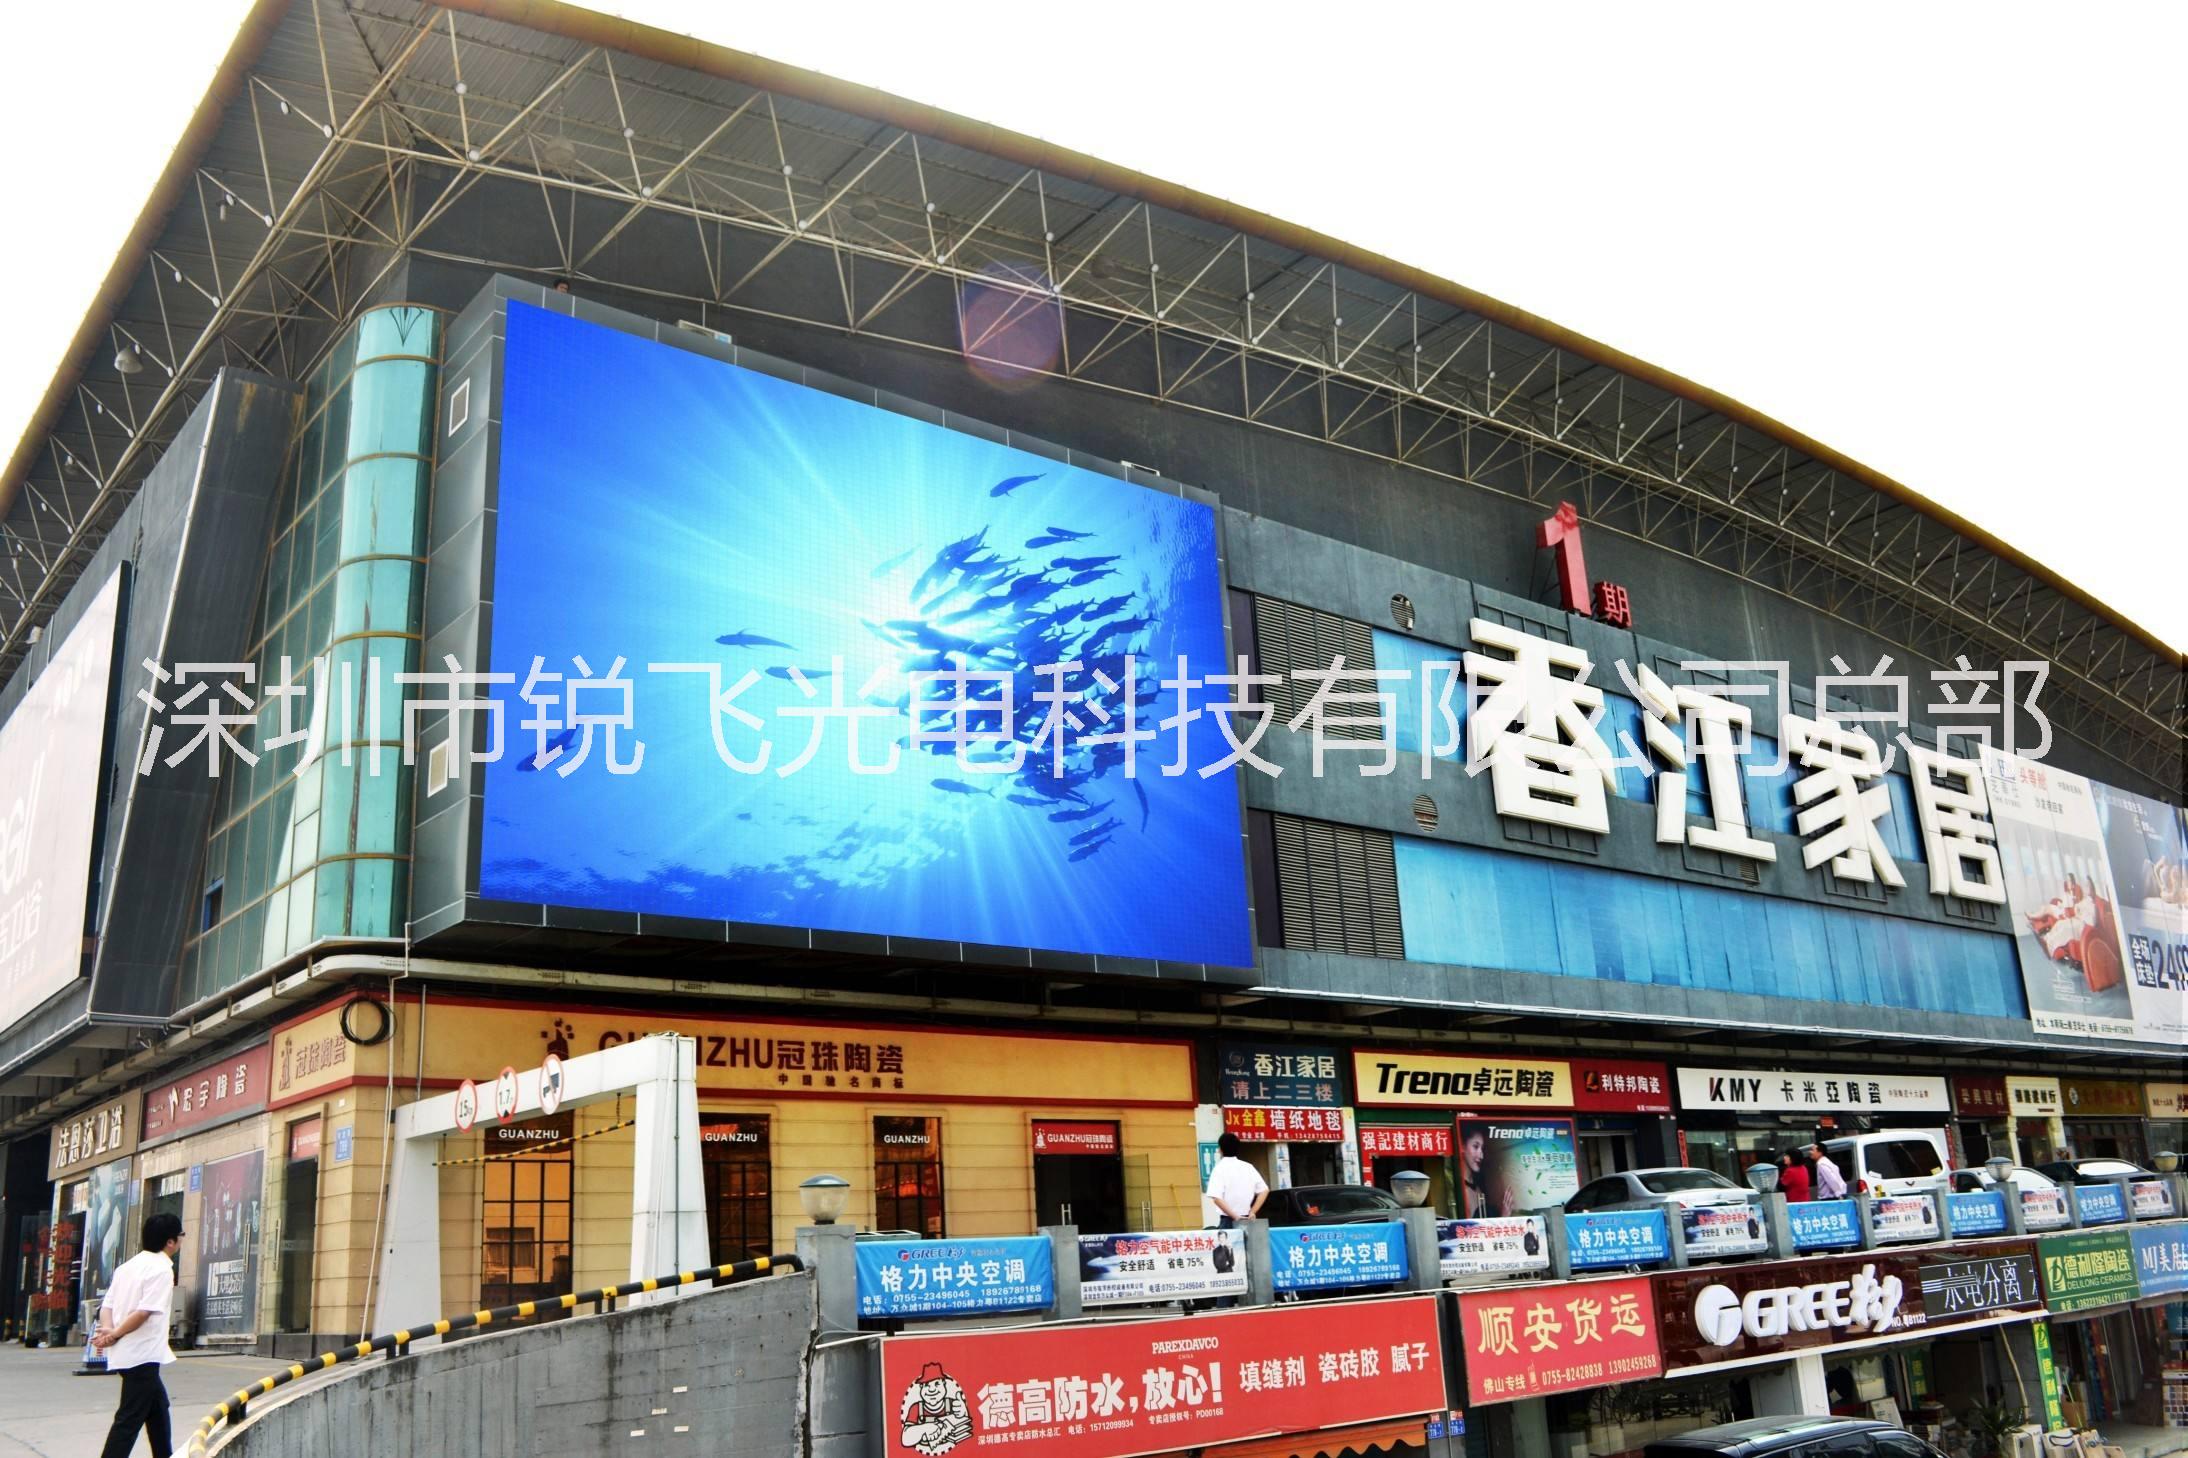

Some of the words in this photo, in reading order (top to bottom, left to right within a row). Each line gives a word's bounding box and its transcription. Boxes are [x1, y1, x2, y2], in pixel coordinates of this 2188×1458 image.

[1463, 618, 2006, 904] 香江家居
[1254, 1053, 1336, 1079] 香江家居
[1231, 1081, 1333, 1102] 请上二三楼
[1601, 1074, 1661, 1094] 利特邦陶瓷
[1709, 1077, 1761, 1103] KMY
[1270, 1110, 1342, 1131] 墙纸地毯
[56, 1104, 125, 1169] 法恩莎卫浴
[498, 1128, 560, 1139] GUANZHU
[704, 1132, 758, 1143] GUANZHU
[884, 1134, 931, 1145] GUANZHU
[1793, 1213, 1849, 1235] 格力中央空调
[1115, 1236, 1215, 1256] 格力空气能中央热水
[1579, 1226, 1654, 1248] 格力中央空调
[1119, 1259, 1155, 1272] 安全舒适
[1187, 1257, 1204, 1268] 75%
[1289, 1241, 1388, 1268] 格力中央空调
[2063, 1248, 2131, 1279] 德利隆陶瓷
[880, 1259, 1026, 1293] 格力中央空调
[1944, 1259, 2022, 1311] 水电分离
[2100, 1272, 2134, 1285] CERAMICS
[893, 1290, 970, 1304] 0755-23496045
[1478, 1293, 1646, 1356] 顺安货运
[1152, 1336, 1219, 1354] PAREXDAVCO
[1239, 1355, 1306, 1393] 填缝剂
[1318, 1347, 1380, 1384] 瓷砖胶
[1391, 1342, 1430, 1374] 腻子
[1483, 1375, 1526, 1395] 佛山专线
[1542, 1363, 1603, 1386] 0755-82428838
[1608, 1354, 1657, 1374] 13902459268
[977, 1428, 1061, 1447] 深圳德高专卖店防水总汇
[1090, 1419, 1134, 1432] 15712099934
